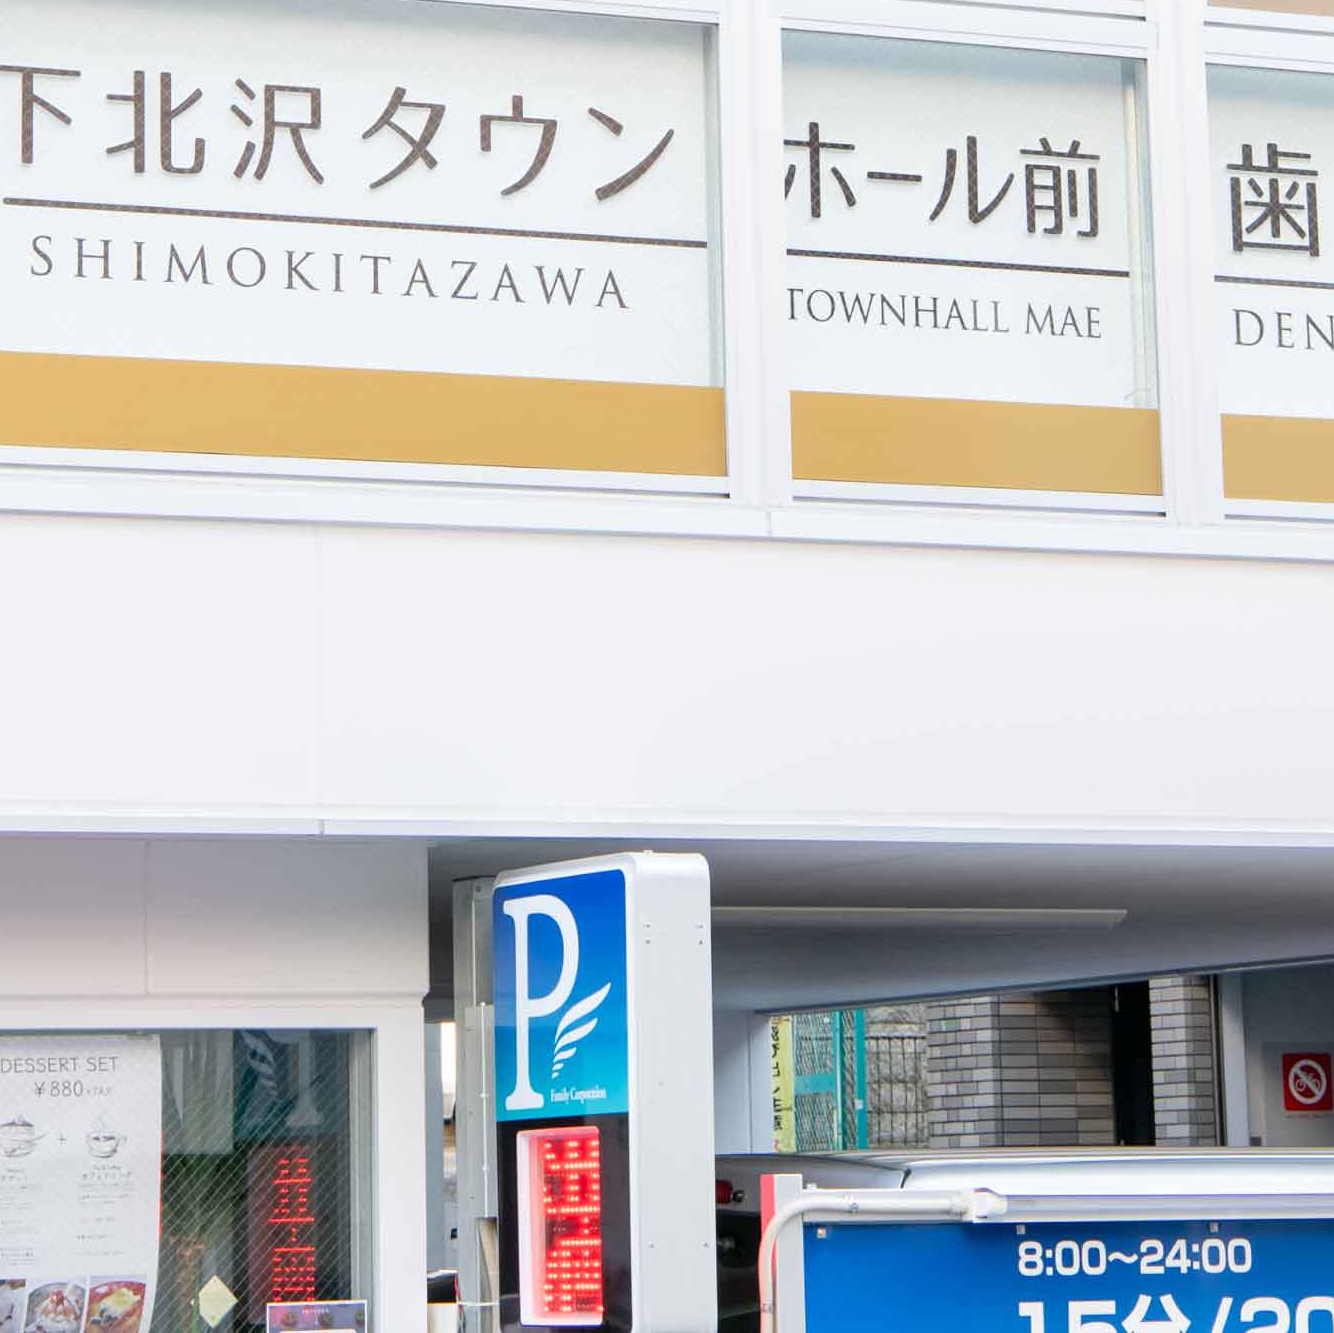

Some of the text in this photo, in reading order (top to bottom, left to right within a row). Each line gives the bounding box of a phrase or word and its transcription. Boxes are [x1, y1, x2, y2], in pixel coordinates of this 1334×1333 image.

[784, 122, 1099, 238] ホール前
[31, 235, 631, 310] SHIMOKITAZAWA
[788, 287, 1009, 334] TOWNHALL
[1026, 304, 1103, 340] MAE
[502, 894, 579, 1111] P
[0, 1057, 119, 1074] DESSERT SET
